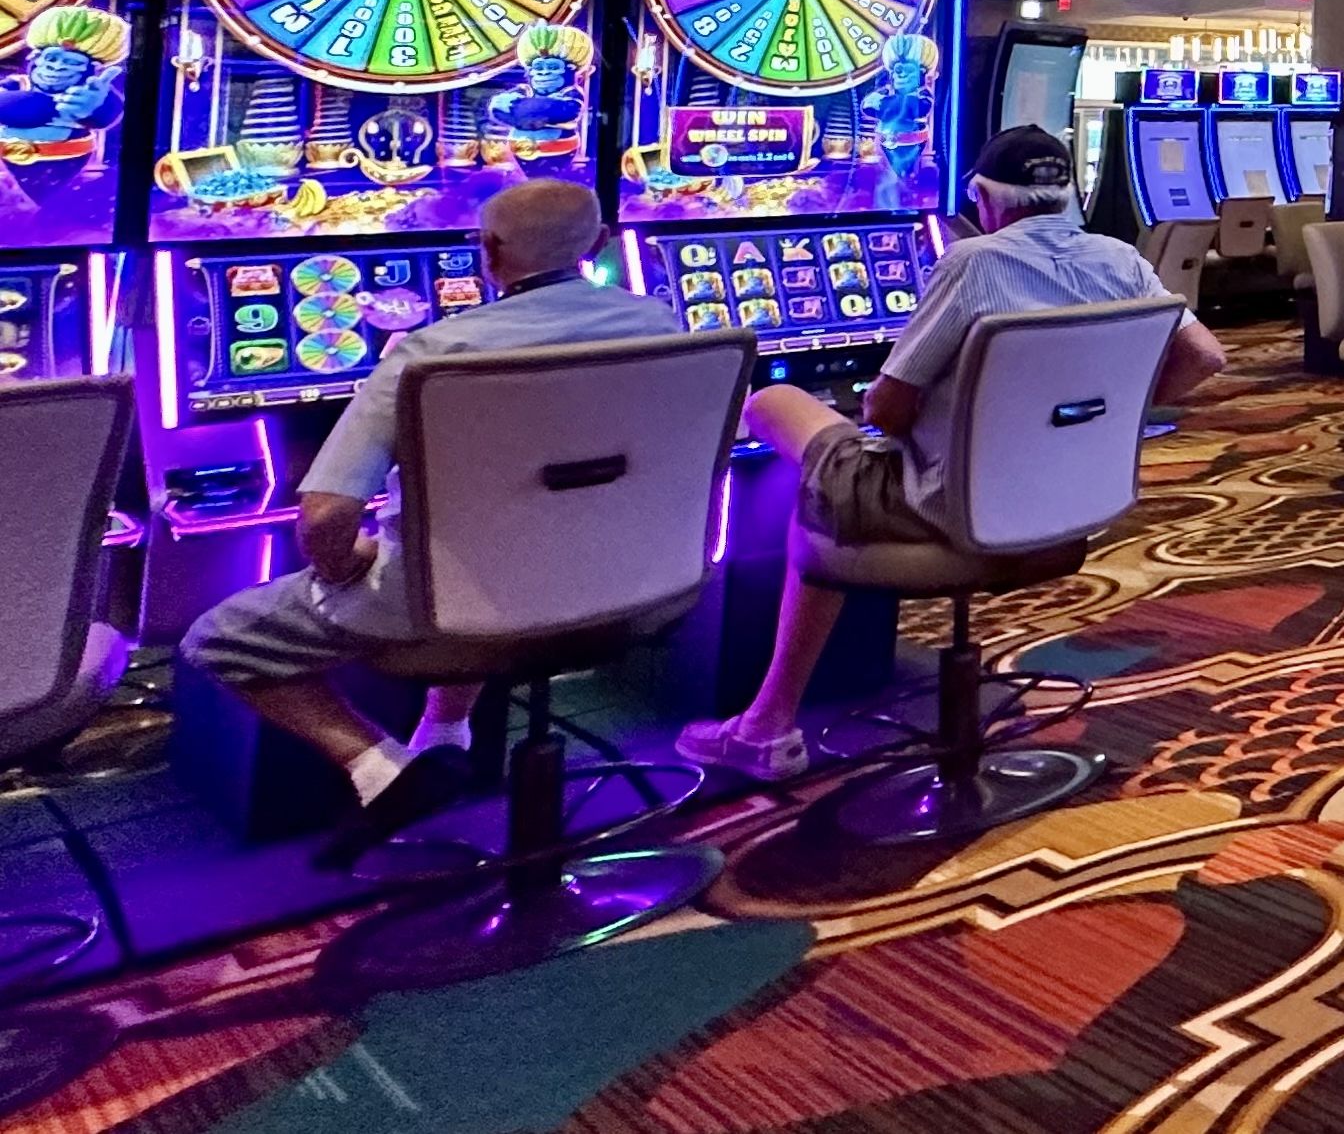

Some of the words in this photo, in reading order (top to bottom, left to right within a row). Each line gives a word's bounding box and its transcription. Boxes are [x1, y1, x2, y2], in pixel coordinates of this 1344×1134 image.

[711, 110, 768, 126] WIN
[687, 128, 746, 143] WHEEL
[747, 128, 788, 142] SPIN
